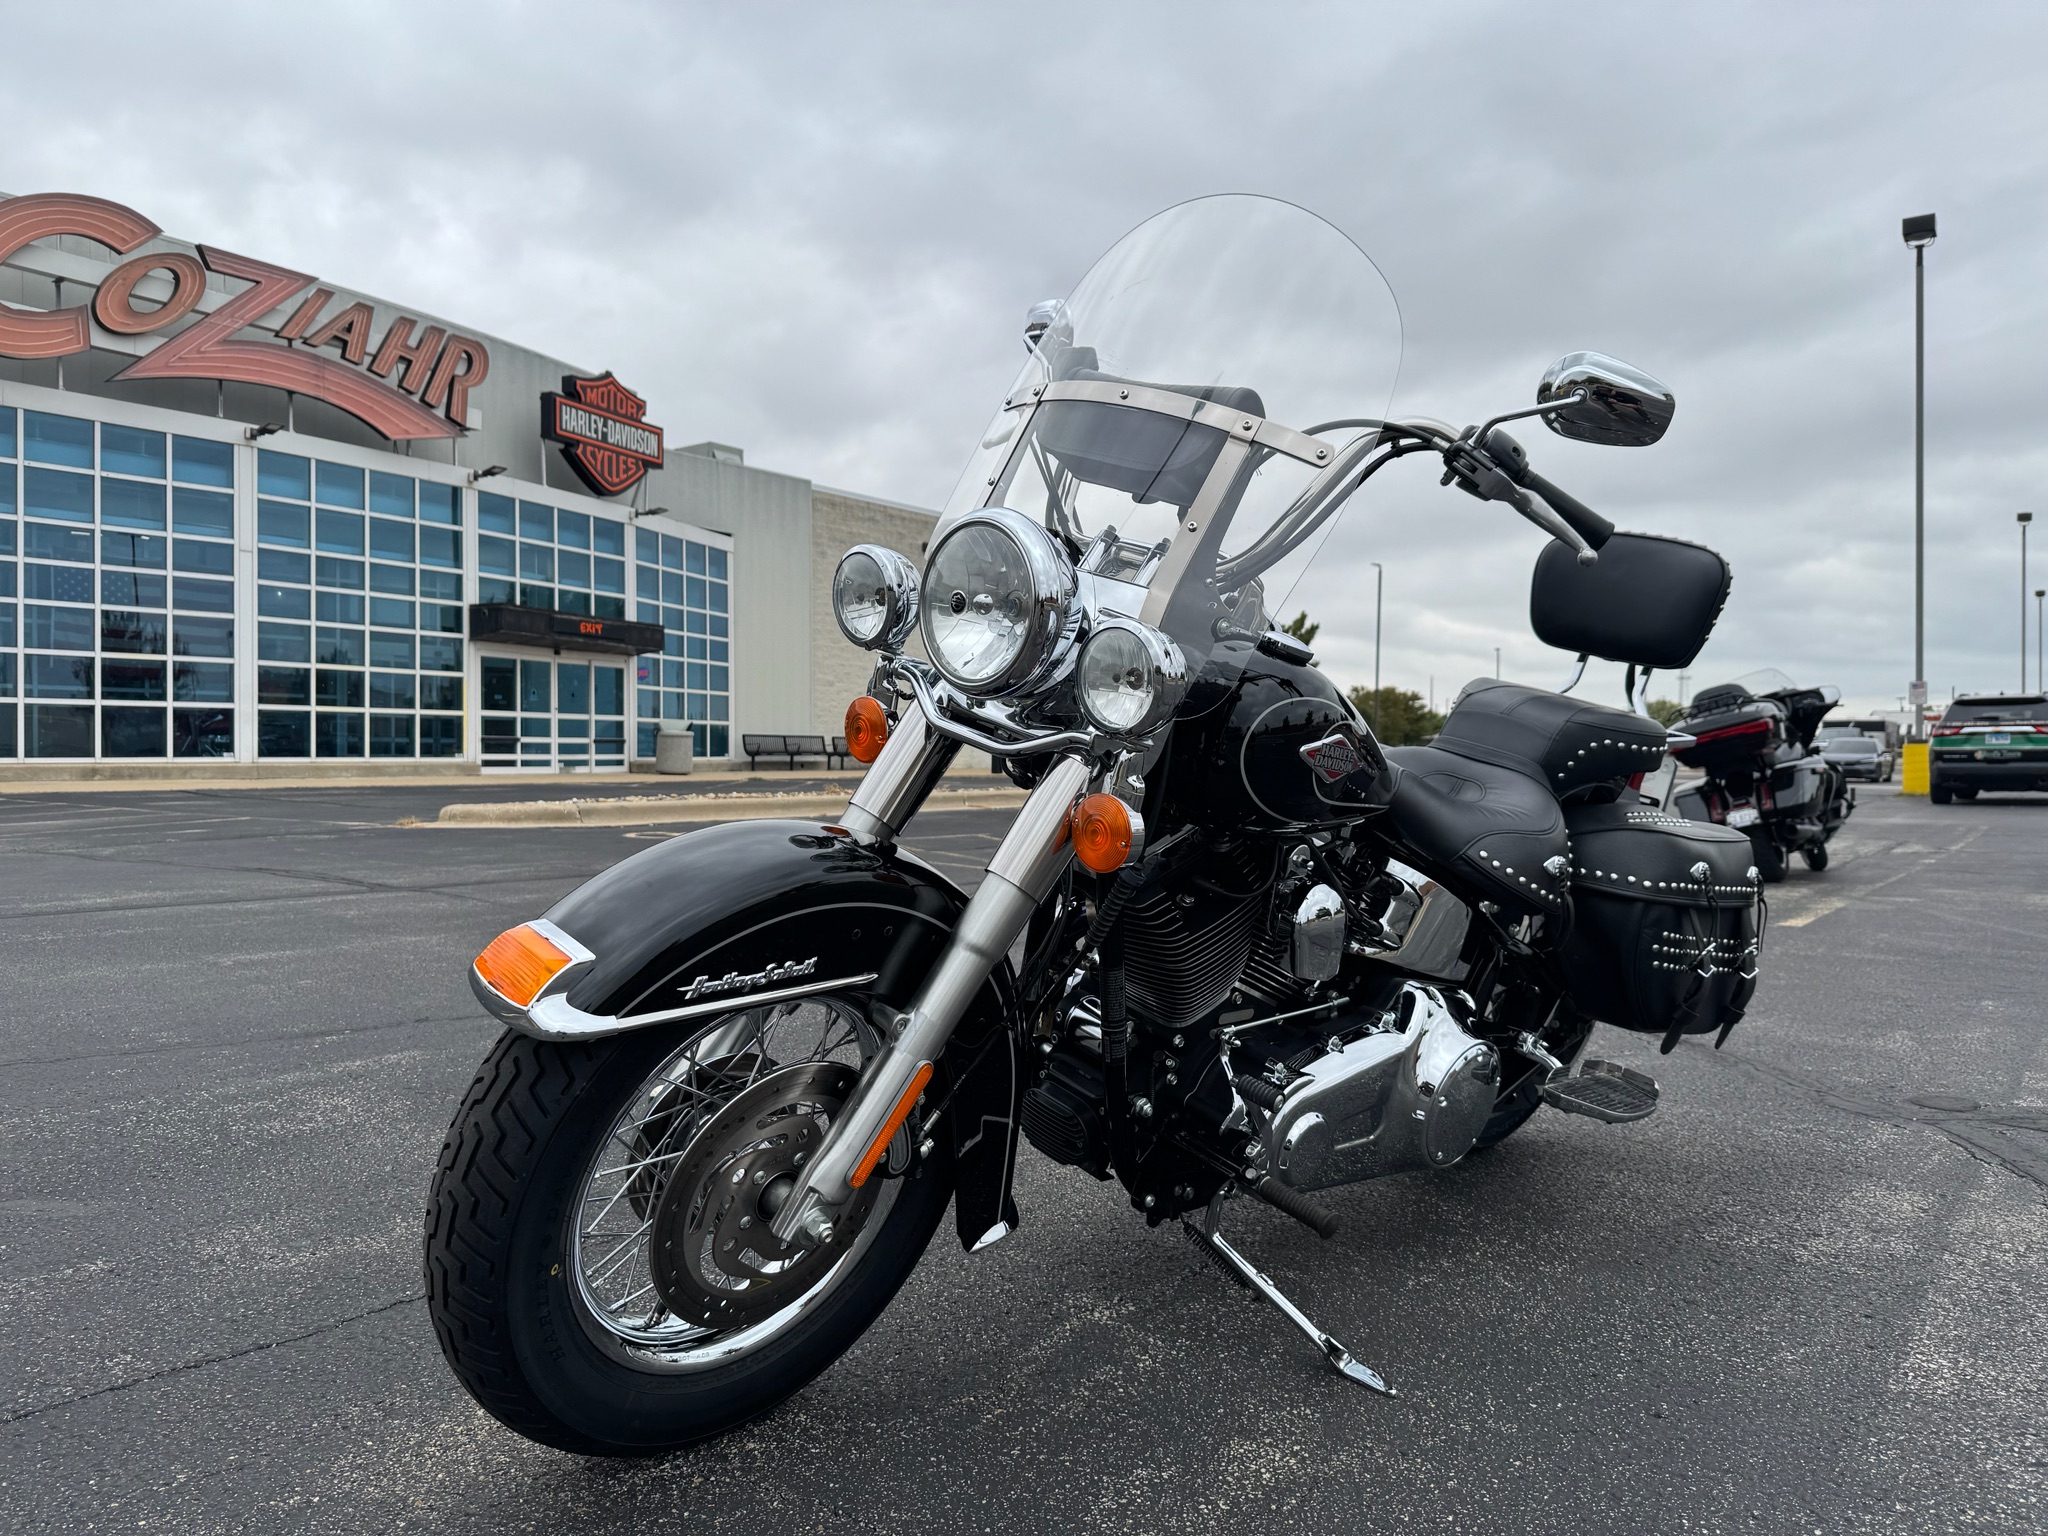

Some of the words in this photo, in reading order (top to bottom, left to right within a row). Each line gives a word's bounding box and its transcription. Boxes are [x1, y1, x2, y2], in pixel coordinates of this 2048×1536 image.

[586, 385, 637, 419] MOTOR
[562, 404, 659, 457] HARLEY-DAVIDSON
[586, 446, 636, 483] CYCLES
[1315, 753, 1353, 773] DAVIDSON
